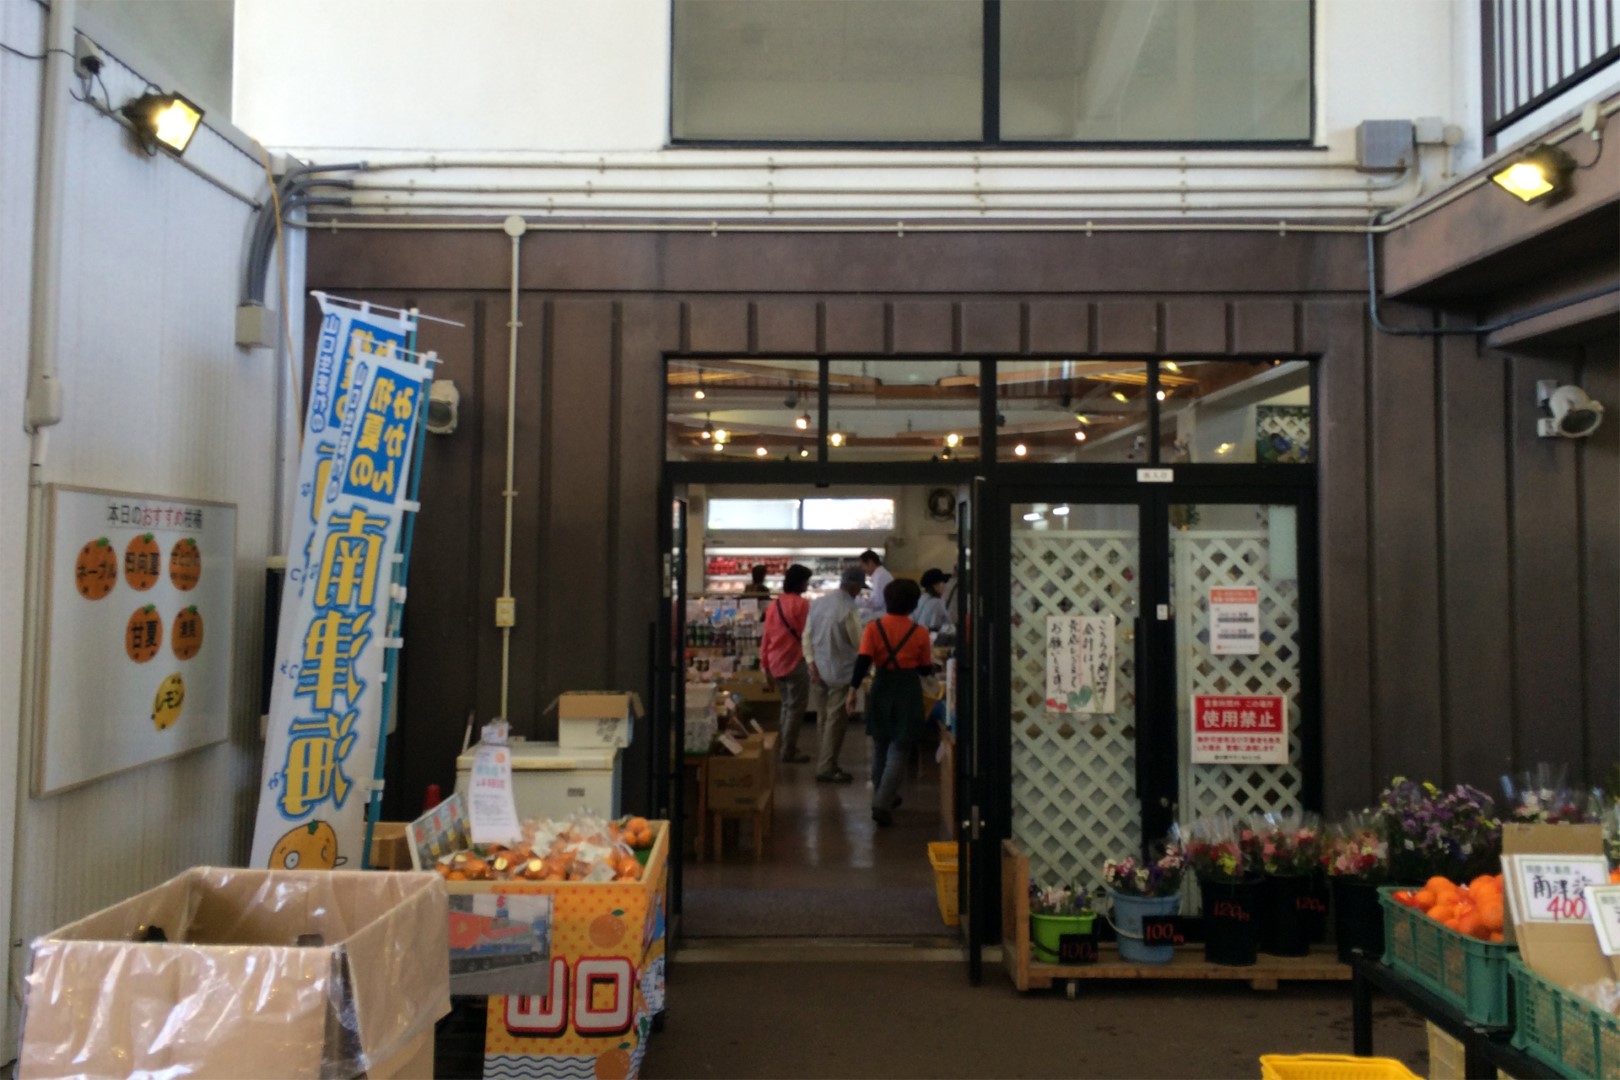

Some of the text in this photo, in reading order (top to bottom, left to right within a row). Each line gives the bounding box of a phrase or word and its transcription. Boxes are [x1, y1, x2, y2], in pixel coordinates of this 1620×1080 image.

[1202, 709, 1276, 728] 使用禁止
[1546, 895, 1587, 921] 400
